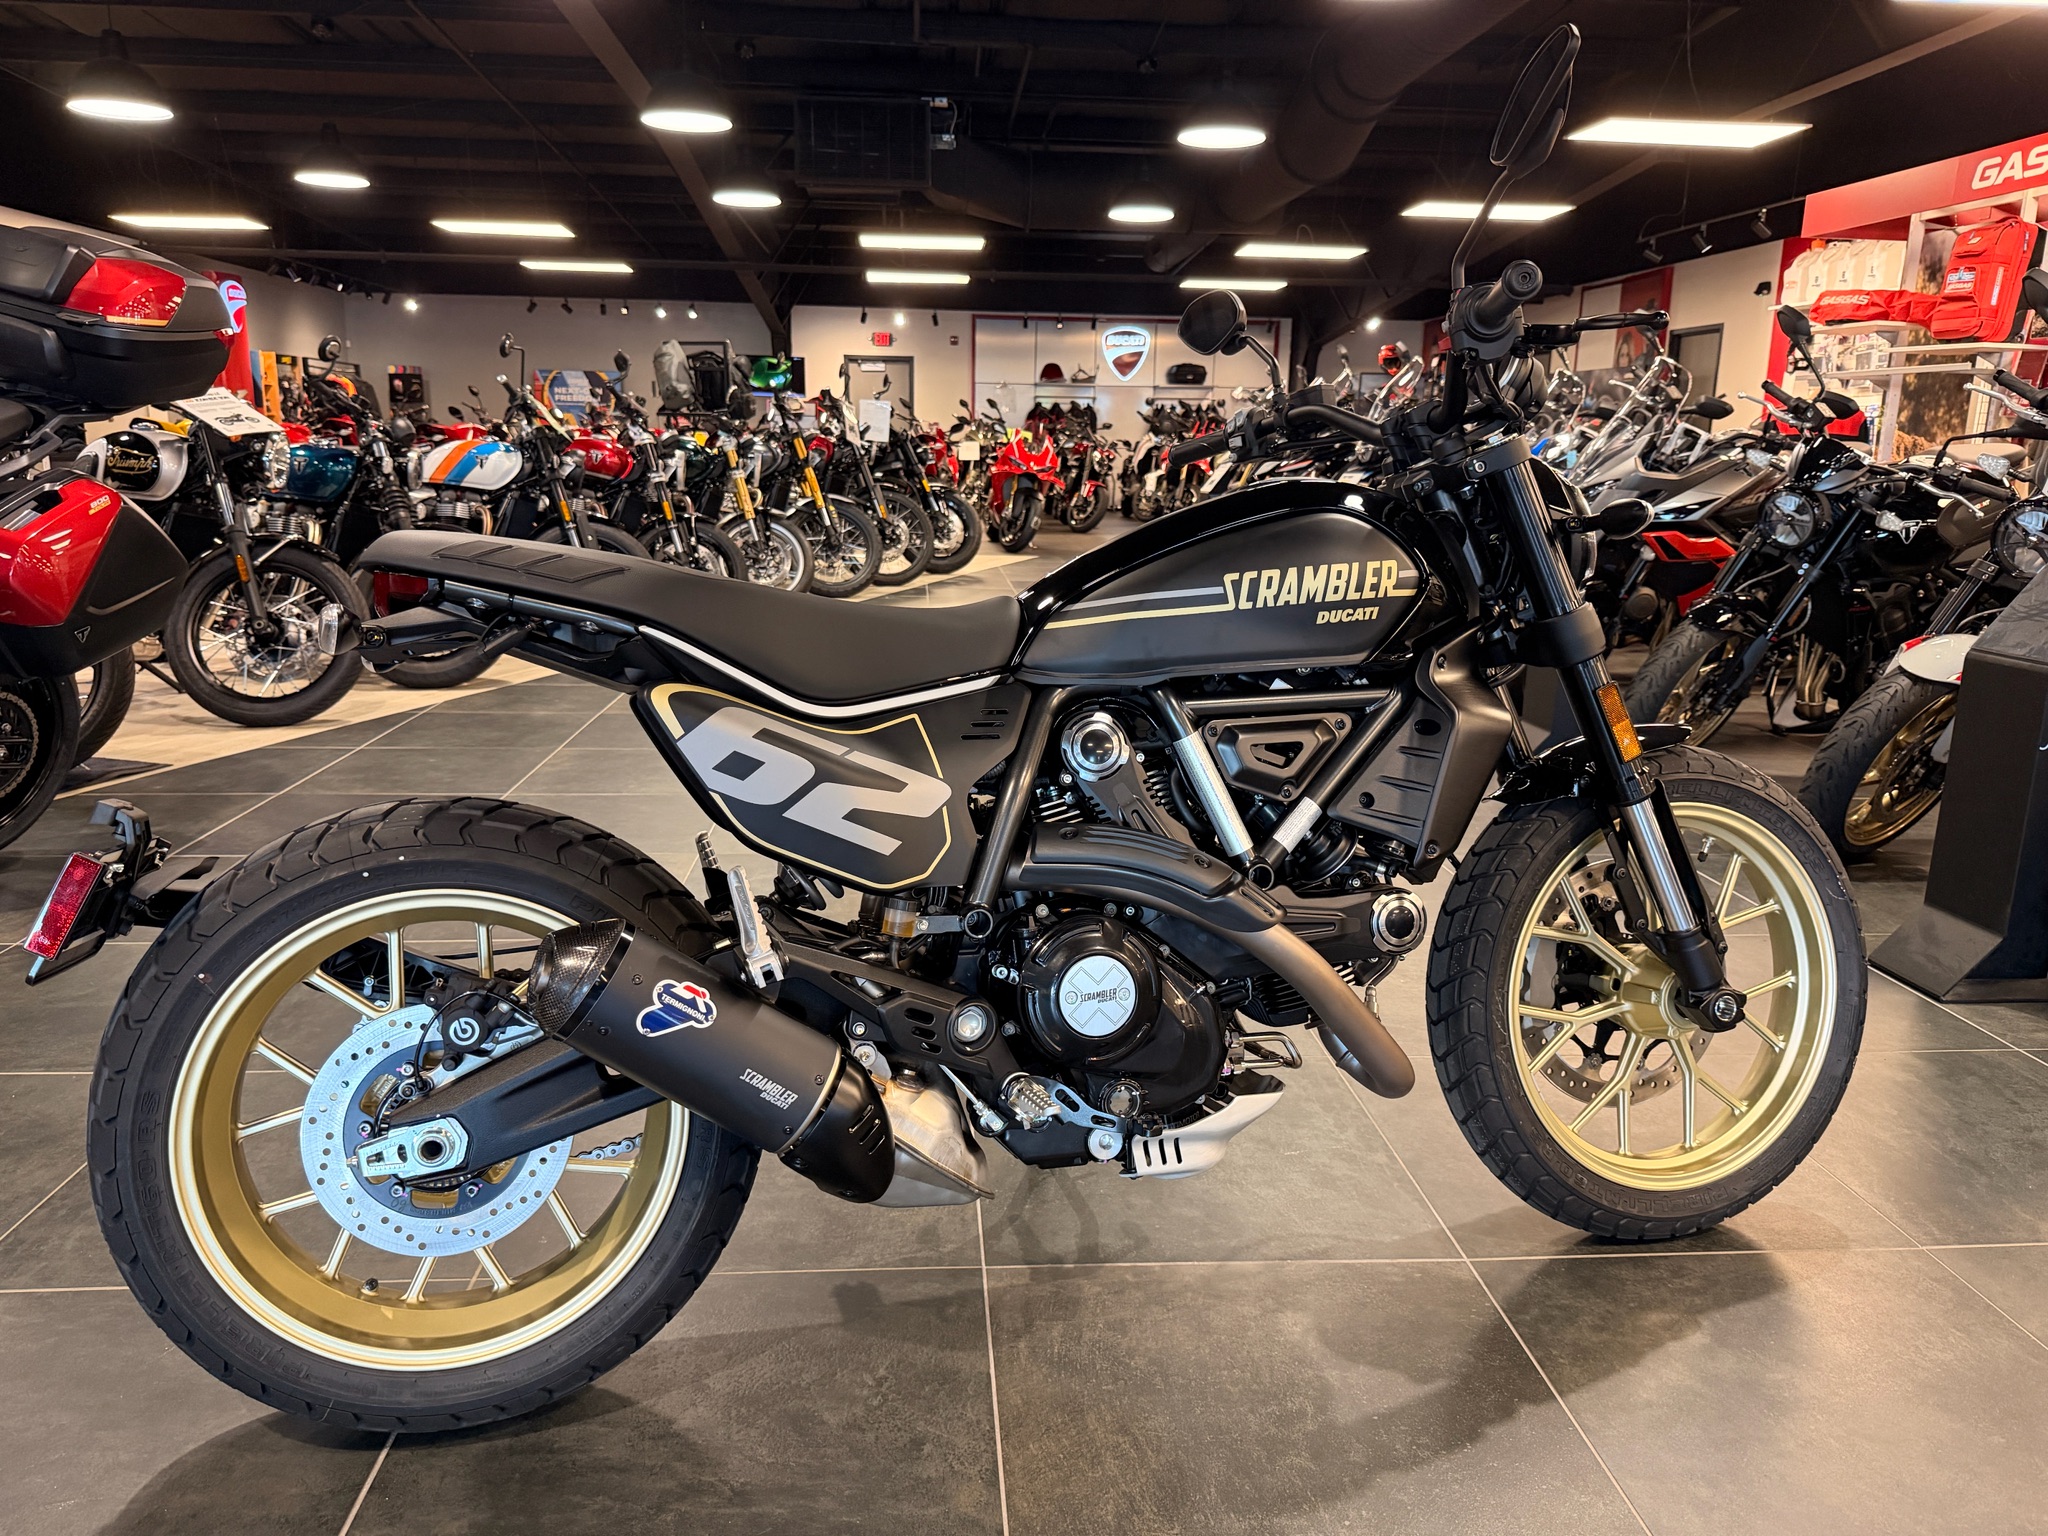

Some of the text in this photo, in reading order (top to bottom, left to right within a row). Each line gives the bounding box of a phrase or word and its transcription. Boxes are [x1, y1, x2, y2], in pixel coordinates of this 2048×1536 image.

[1820, 294, 1870, 305] GASGAS
[874, 333, 890, 345] EXIT
[554, 387, 603, 395] NEXT-GN
[107, 446, 154, 473] Triumph
[1223, 559, 1399, 611] SCRAMBLER
[1316, 606, 1380, 625] DUCATI
[677, 706, 952, 856] 62
[1665, 782, 1732, 800] RELLI
[1080, 987, 1118, 1003] SCRAMBLER
[660, 993, 707, 1023] TERMIGNONI
[739, 1068, 799, 1105] SCRAMBLER
[760, 1091, 790, 1110] DUCATI
